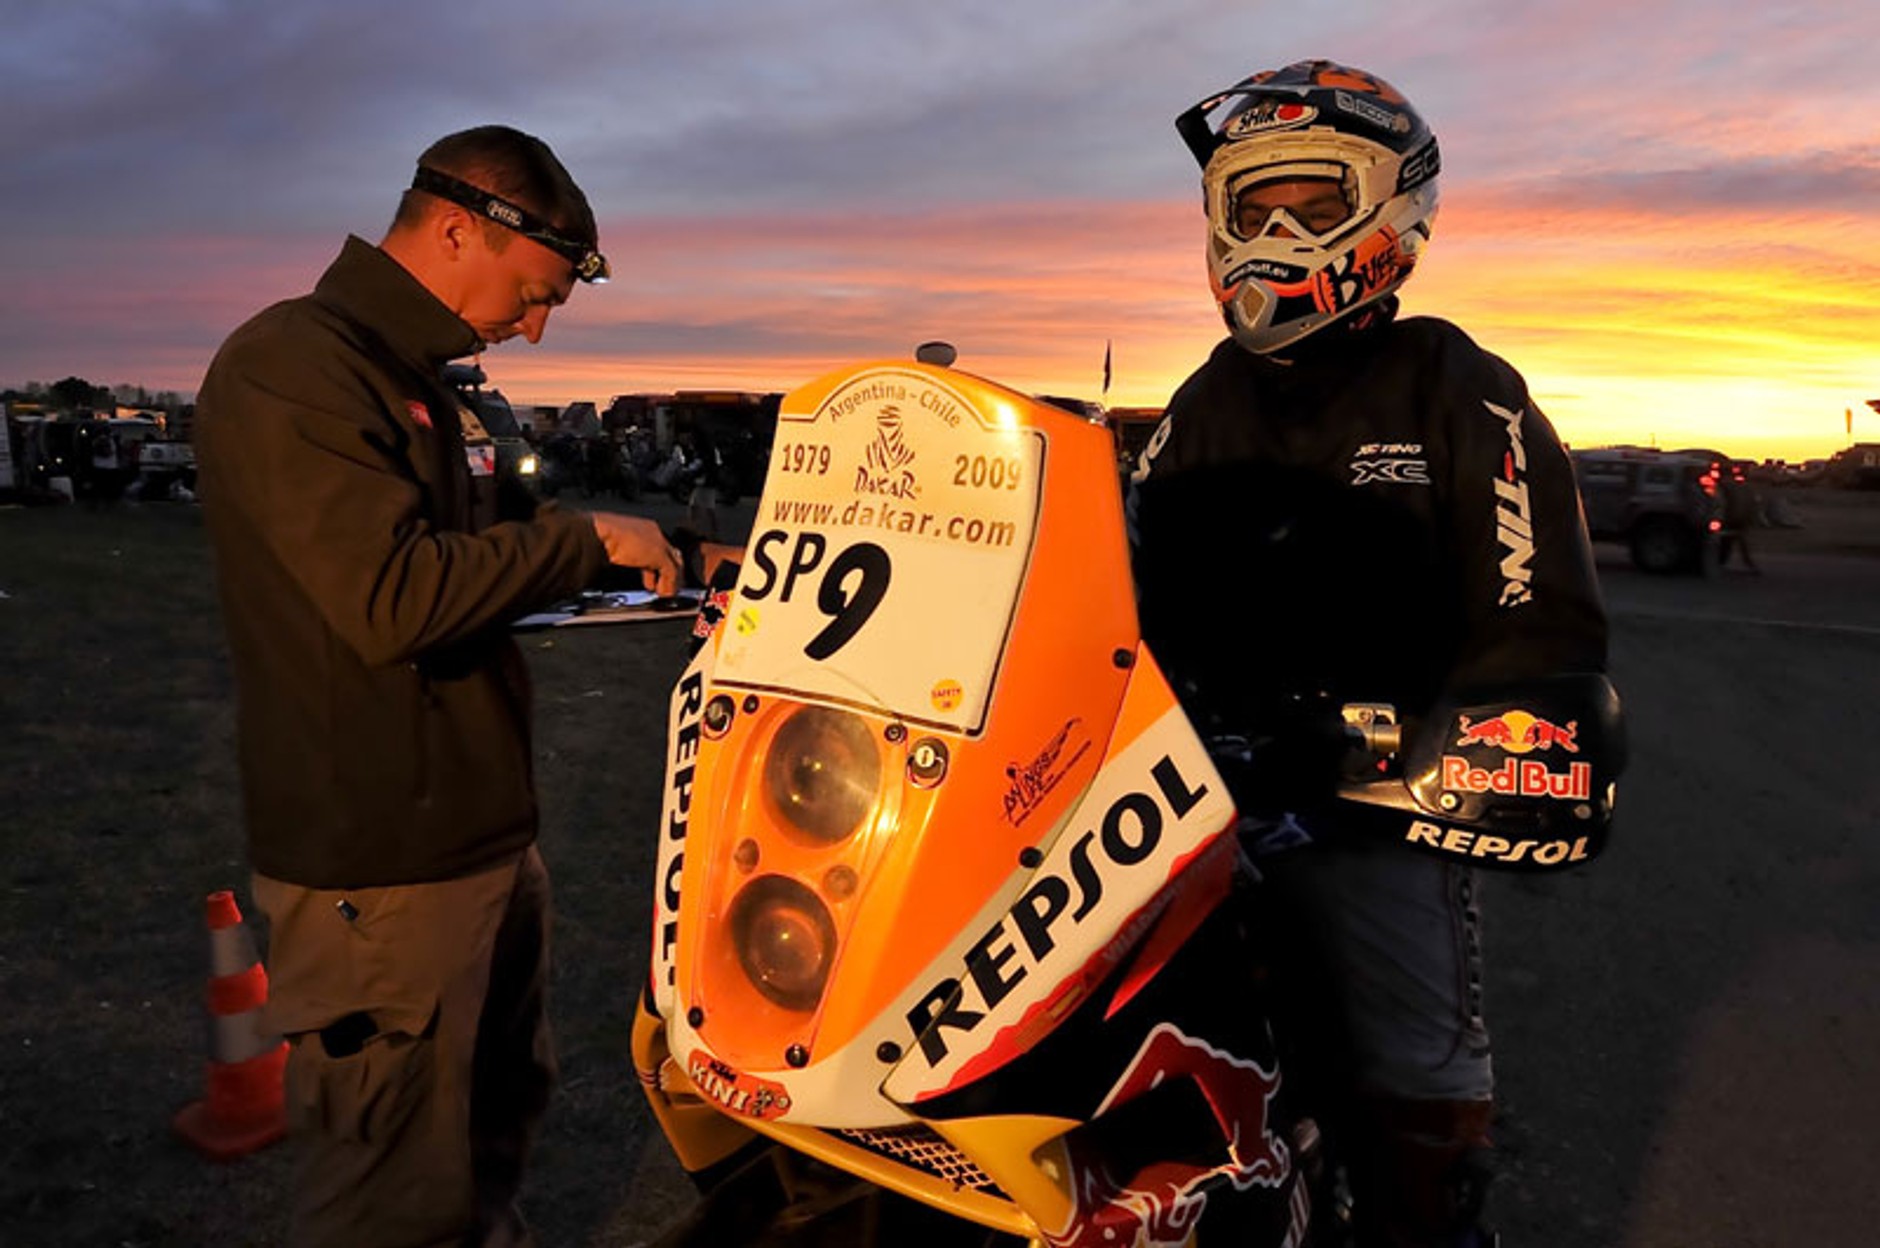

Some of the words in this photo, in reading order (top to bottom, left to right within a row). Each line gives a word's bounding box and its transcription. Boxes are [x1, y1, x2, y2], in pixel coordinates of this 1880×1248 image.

[829, 381, 906, 423] Argentina
[918, 390, 962, 428] Chile
[781, 443, 832, 476] 1979
[953, 453, 1023, 491] 2009
[772, 500, 1016, 546] www.dakar.com
[740, 528, 827, 603] SP
[804, 541, 893, 661] 9
[1442, 755, 1516, 796] Red
[1520, 759, 1592, 800] Bull
[1405, 820, 1589, 866] REPSOL
[906, 754, 1209, 1069] REPSOL
[689, 1061, 752, 1112] KINI
